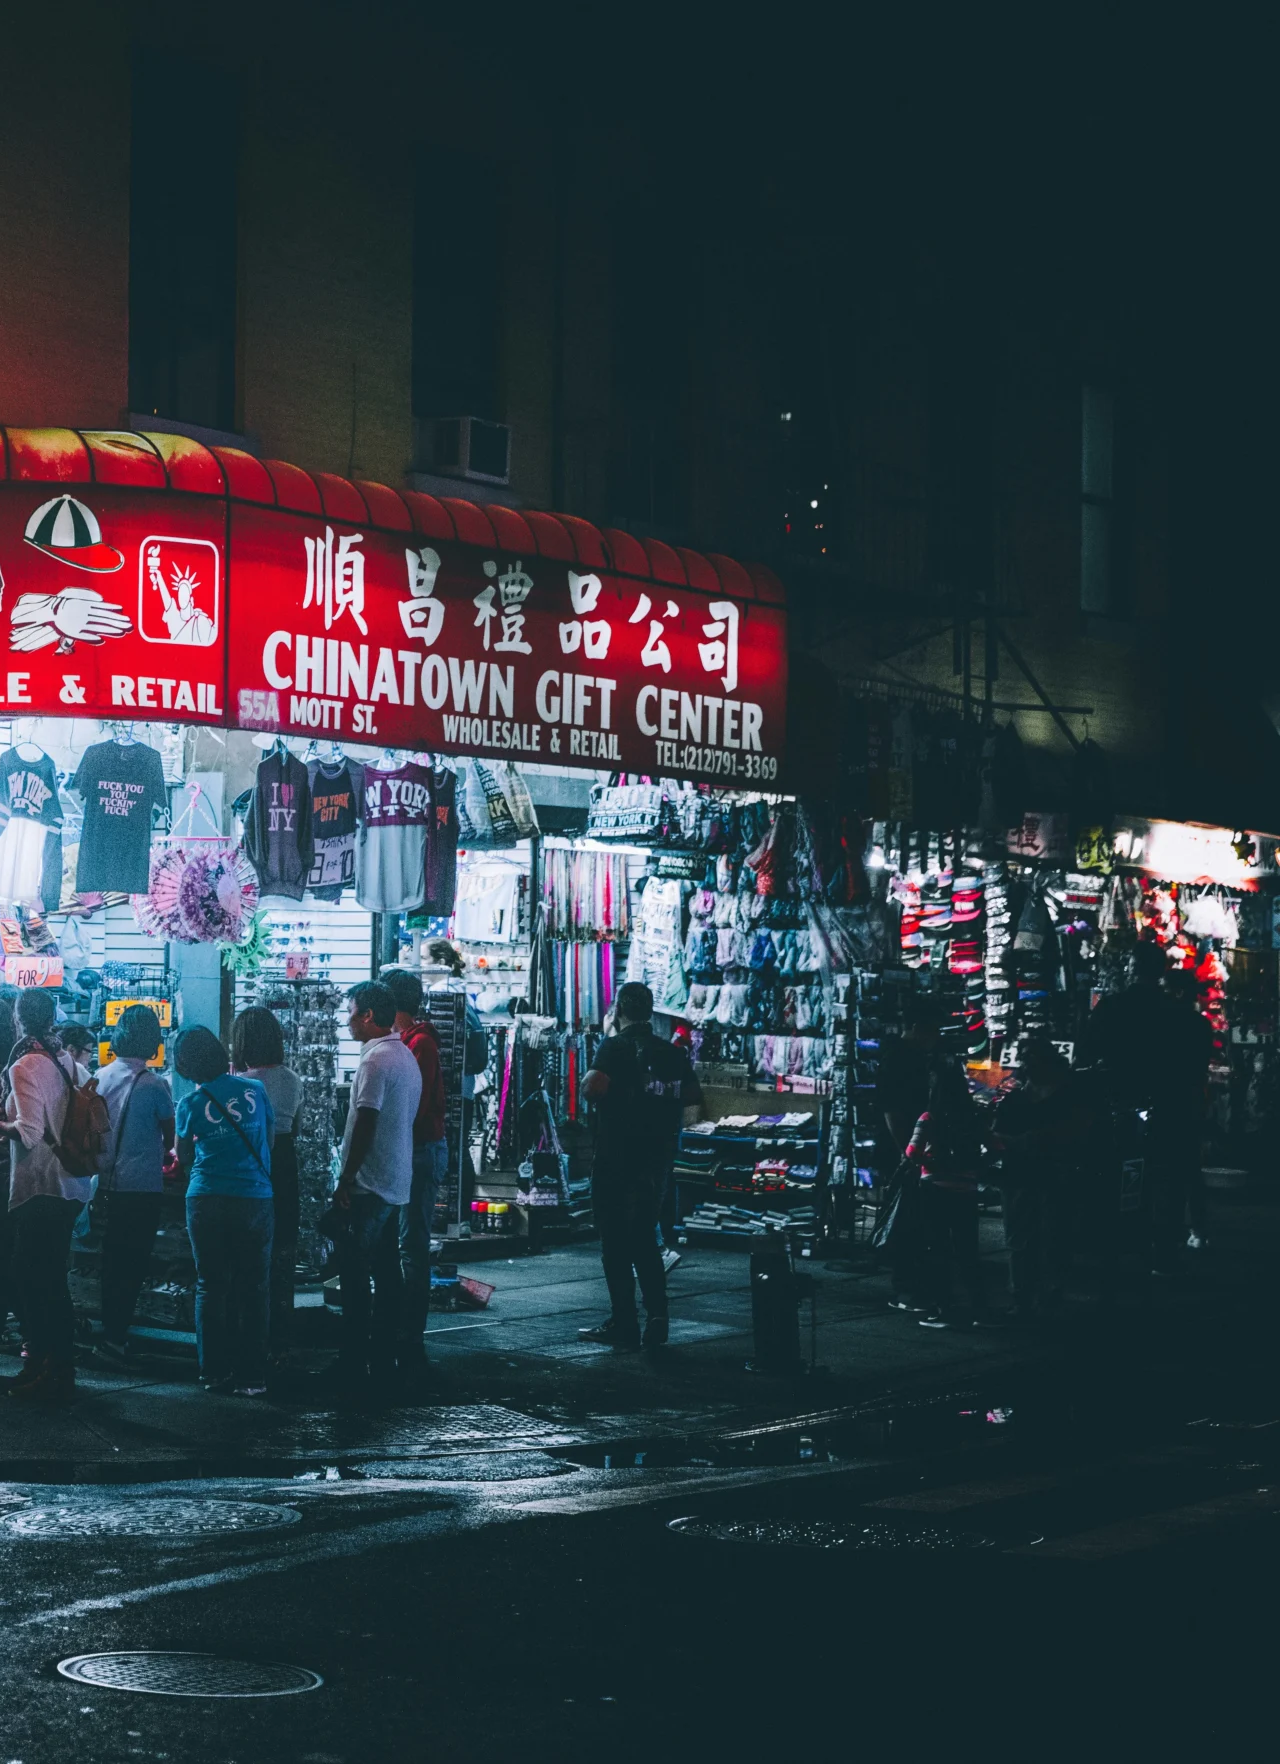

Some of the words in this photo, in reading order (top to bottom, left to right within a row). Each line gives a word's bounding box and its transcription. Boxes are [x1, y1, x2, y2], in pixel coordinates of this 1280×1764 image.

[302, 525, 740, 694] 順昌禮品公司
[59, 674, 86, 705] &
[111, 674, 223, 716] RETAIL
[262, 630, 515, 719] CHINATOWN
[536, 670, 617, 731] GIFT
[635, 684, 763, 752] CENTER
[238, 689, 280, 723] 55A
[290, 694, 344, 731] MOTT
[352, 705, 378, 735] ST.
[442, 714, 540, 752] WHOLESALE
[549, 729, 561, 754] &
[570, 728, 622, 761] RETAIL
[98, 780, 122, 792] FUCK
[124, 783, 145, 794] YOU
[110, 791, 129, 800] YOU
[271, 782, 279, 805] I
[99, 797, 137, 809] FUCKIN'
[104, 807, 129, 817] FUCK
[313, 795, 329, 814] NEW
[329, 792, 349, 810] YORK
[321, 806, 340, 822] CITY
[366, 804, 422, 819] ITY
[268, 808, 296, 832] NY
[594, 814, 617, 828] NEW
[618, 813, 643, 827] YORK
[6, 956, 17, 985] 3
[17, 970, 38, 986] FOR
[1002, 1052, 1012, 1065] 5
